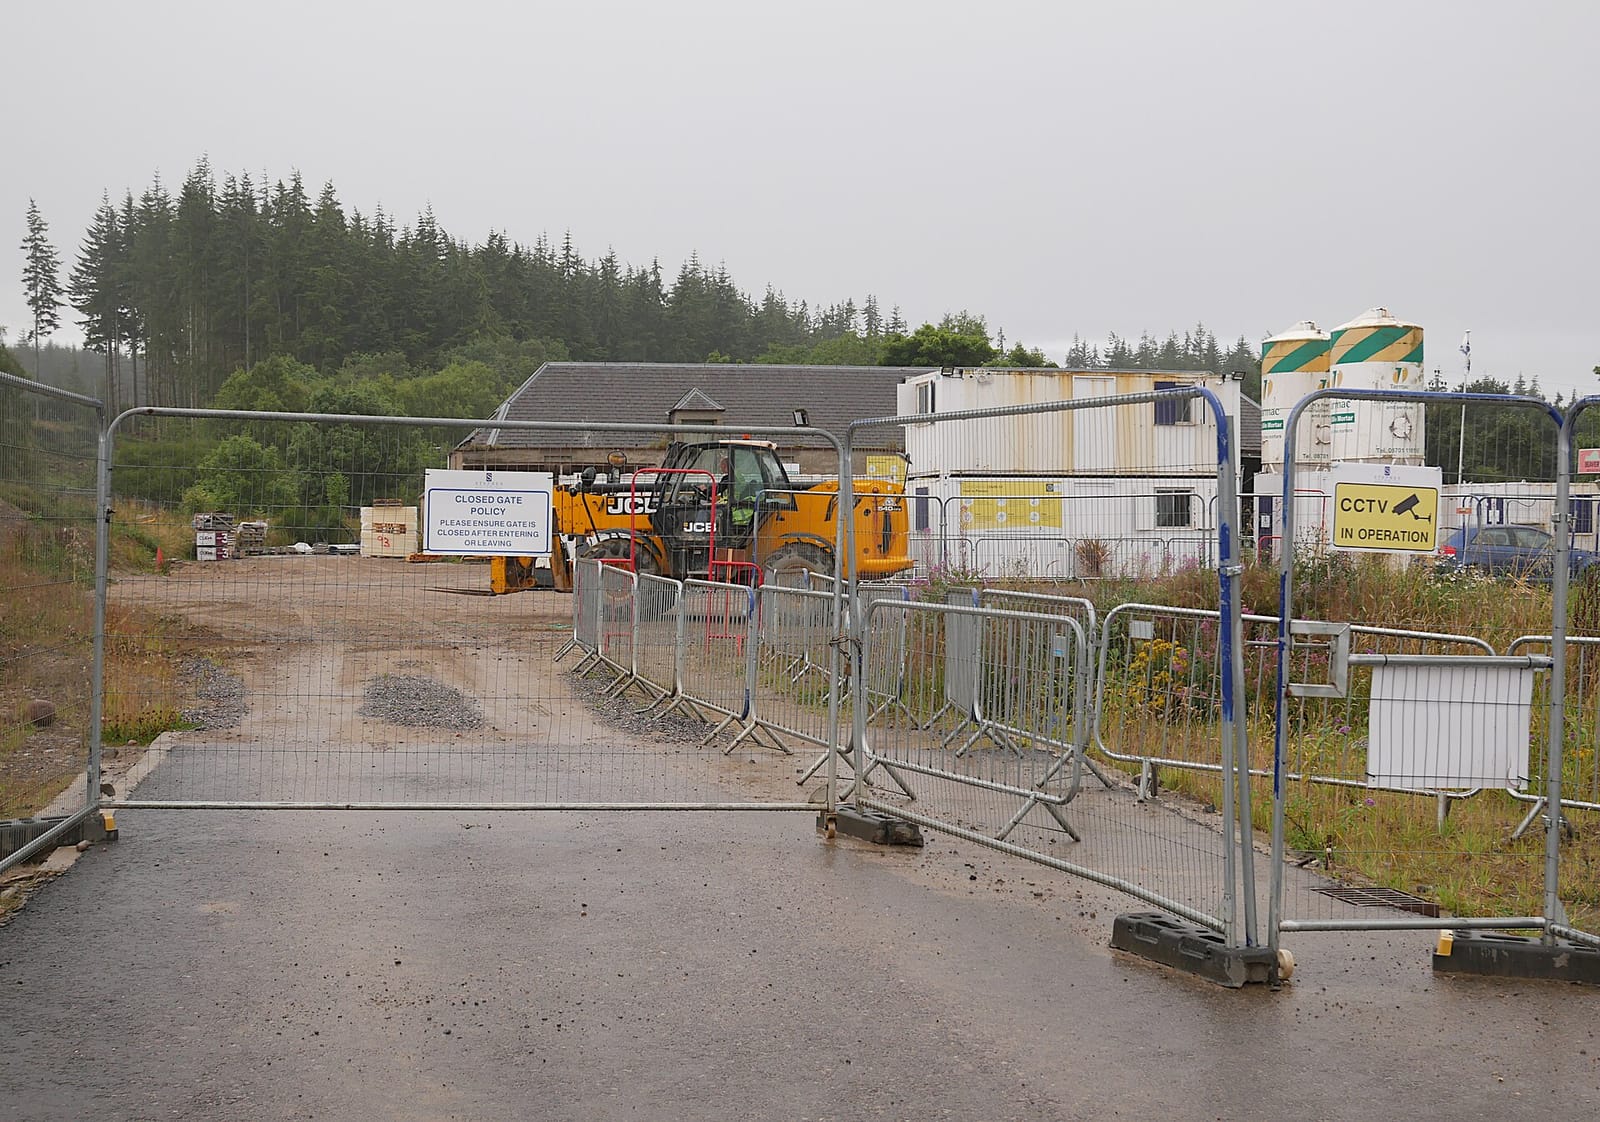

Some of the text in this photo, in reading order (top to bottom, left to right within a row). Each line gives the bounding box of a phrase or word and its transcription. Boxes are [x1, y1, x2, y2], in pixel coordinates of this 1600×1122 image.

[455, 495, 523, 505] CLOSED GATE
[1340, 498, 1388, 513] CCTV
[470, 507, 506, 516] POLICY
[440, 519, 472, 527] PLEASE
[683, 521, 717, 533] JCB
[437, 529, 470, 537] CLOSED
[1341, 528, 1429, 543] IN OPERATION
